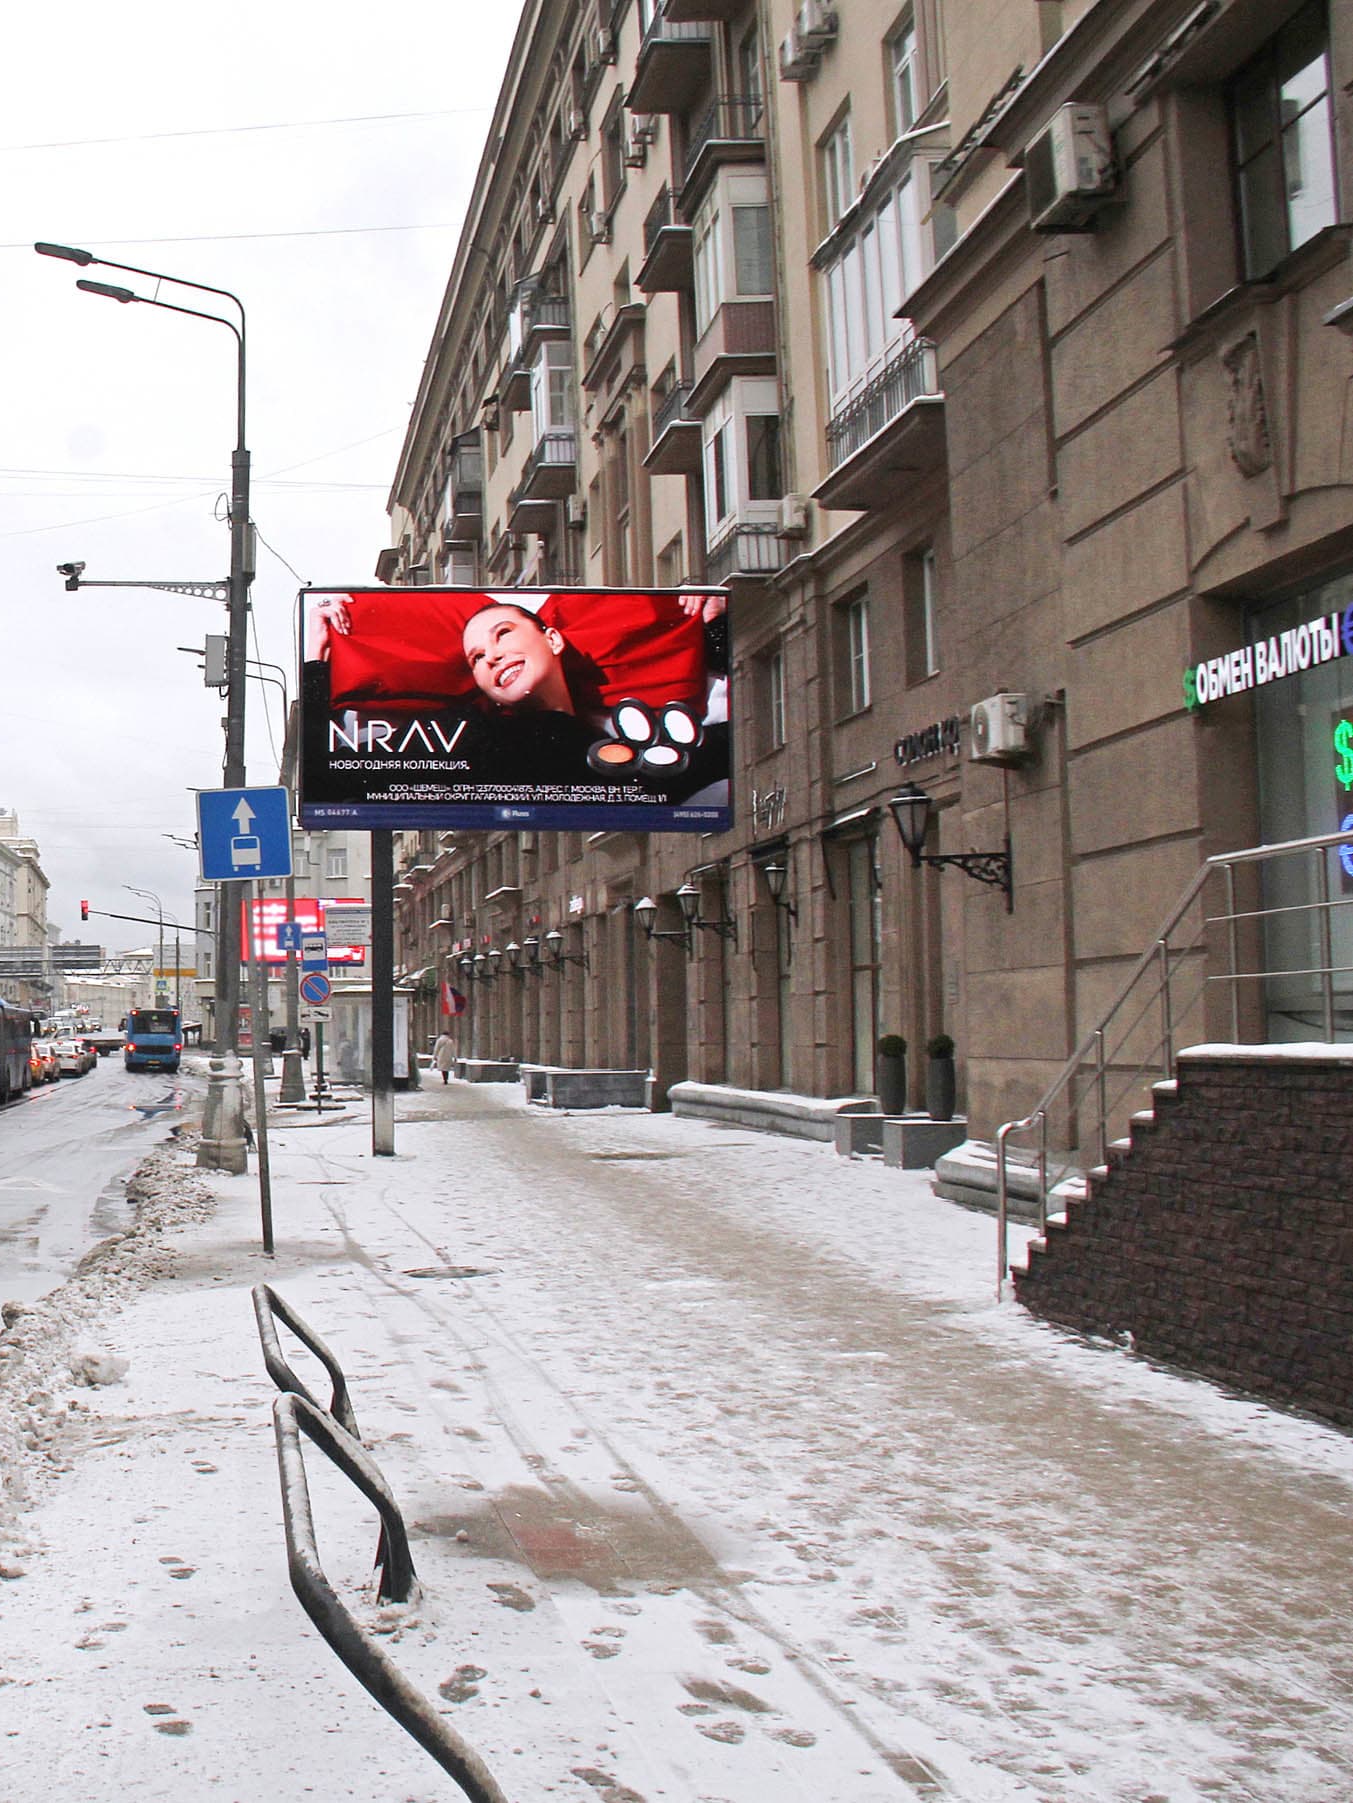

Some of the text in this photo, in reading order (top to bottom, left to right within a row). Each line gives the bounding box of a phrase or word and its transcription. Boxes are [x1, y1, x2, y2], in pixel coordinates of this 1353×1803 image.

[1196, 646, 1254, 704] ОБМЕН
[1254, 612, 1340, 685] ВАЛЮТЫ
[329, 719, 467, 753] NRAV
[329, 760, 470, 770] НОВОГОДНЯЯ КОЛЛЕКЦИЯ.
[389, 784, 409, 792] ООО
